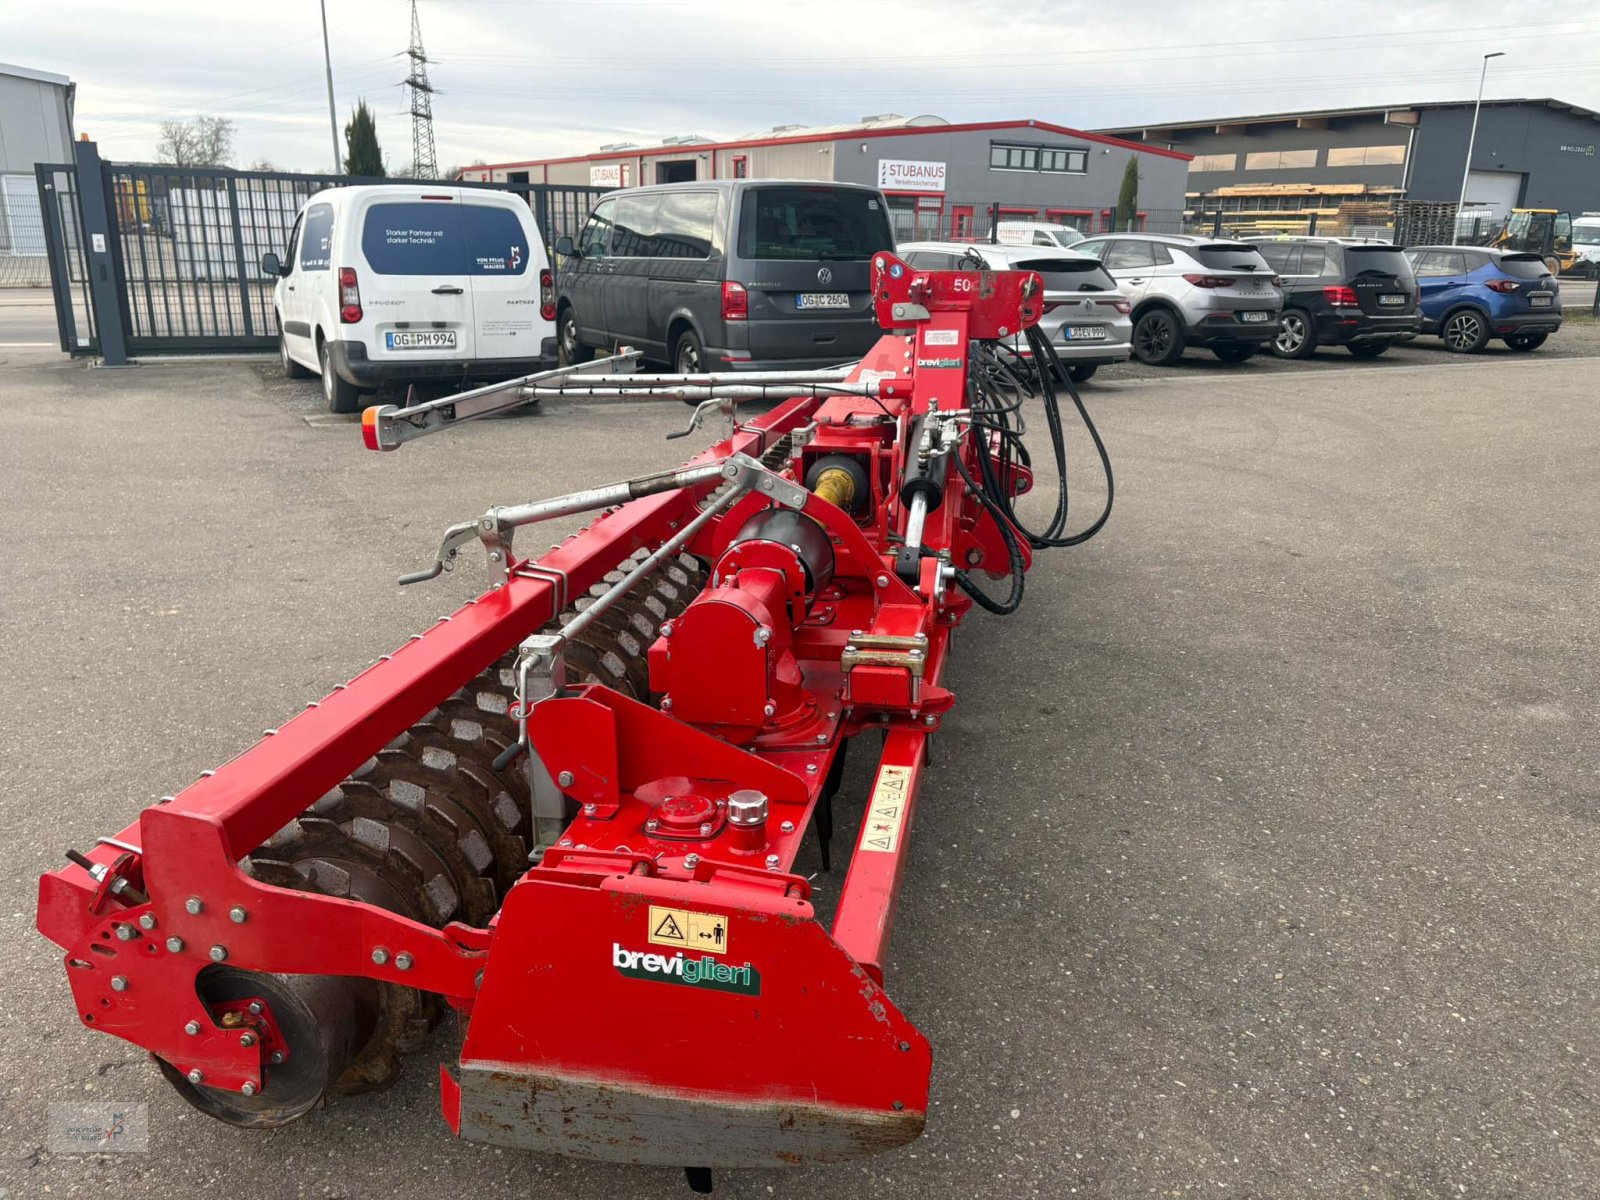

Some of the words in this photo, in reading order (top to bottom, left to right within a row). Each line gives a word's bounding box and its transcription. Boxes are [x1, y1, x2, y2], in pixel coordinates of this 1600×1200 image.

[889, 164, 945, 178] STUBANUS
[803, 295, 814, 305] OG
[820, 295, 826, 305] C
[827, 296, 848, 305] 2604
[1092, 327, 1105, 337] 999
[394, 334, 409, 345] OG
[416, 334, 431, 345] PM
[433, 333, 454, 345] 994
[612, 942, 751, 986] breviglieri
